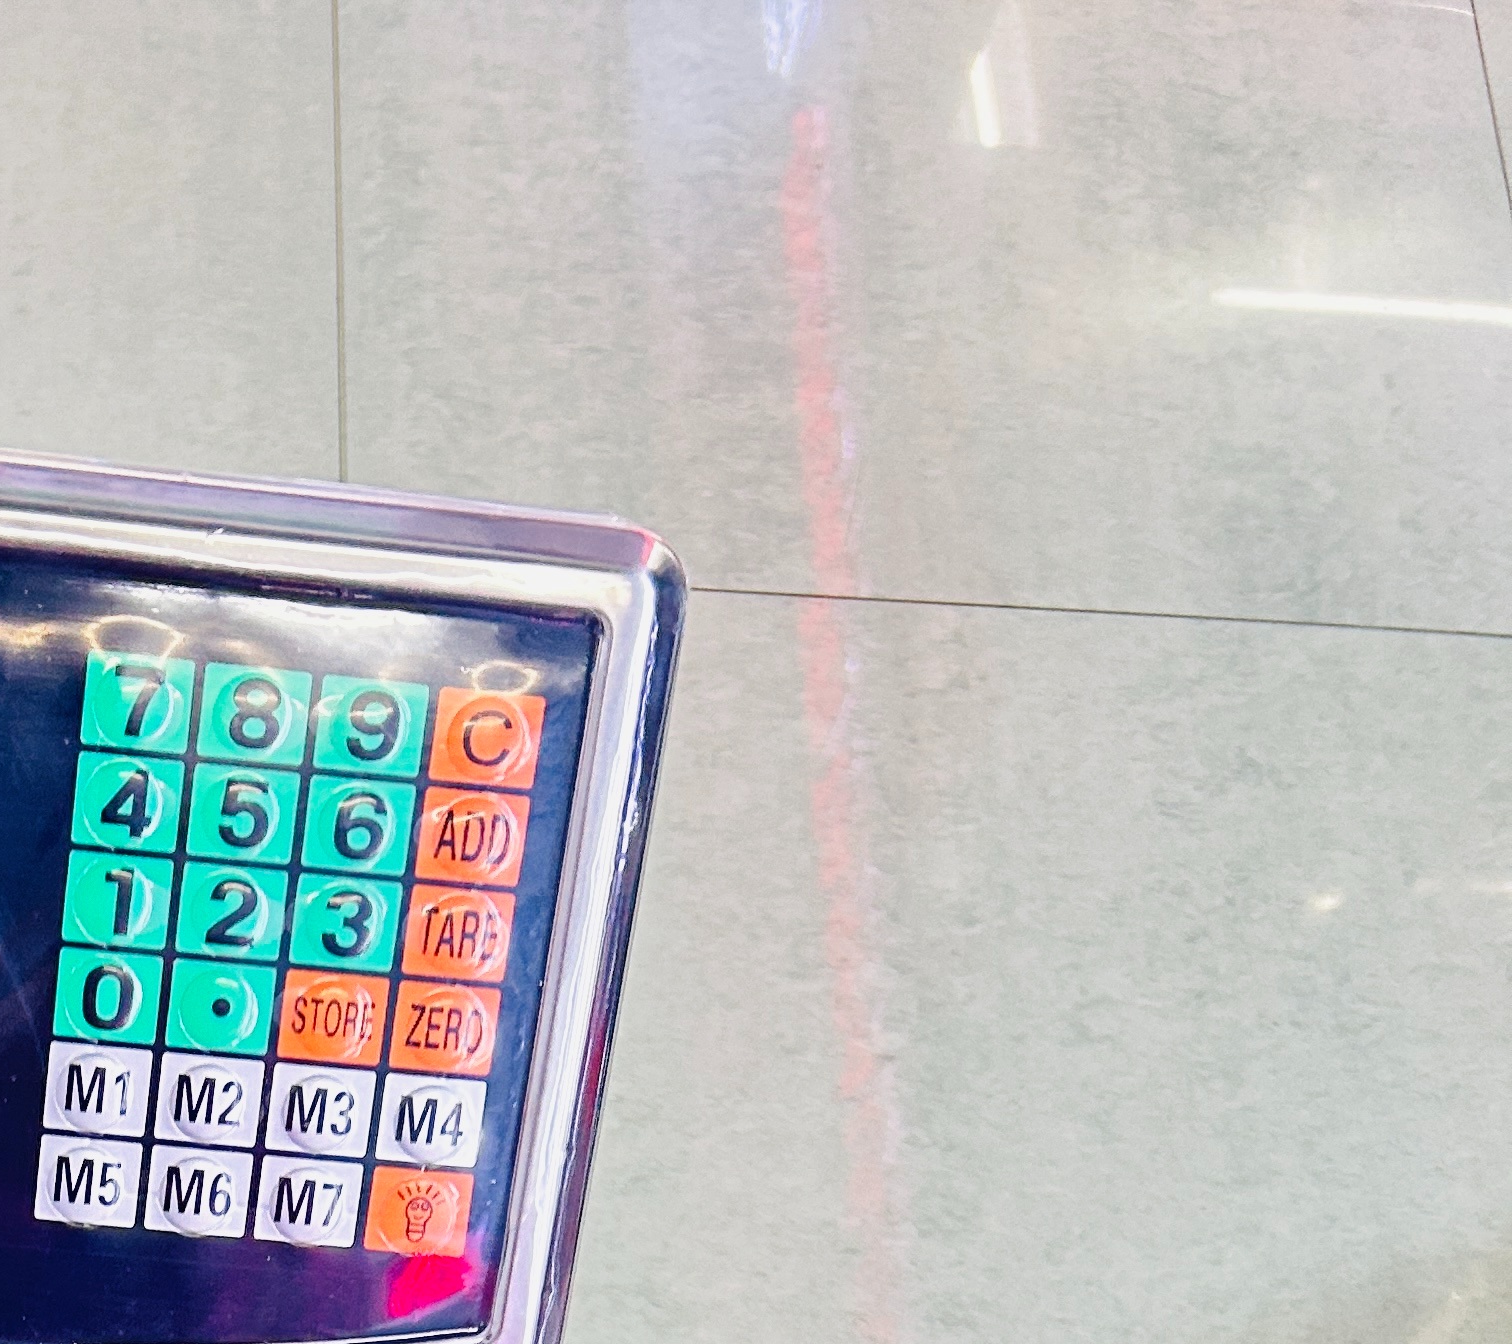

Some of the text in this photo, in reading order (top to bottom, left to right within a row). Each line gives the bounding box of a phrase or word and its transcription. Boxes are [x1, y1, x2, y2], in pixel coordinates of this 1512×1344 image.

[115, 665, 166, 737] 7
[229, 677, 283, 749] 8
[345, 690, 401, 761] 9
[462, 710, 512, 768] C
[101, 769, 152, 839] 4
[218, 779, 271, 848] 5
[333, 791, 388, 860] 6
[433, 809, 511, 865] ADD
[105, 867, 135, 937] 1
[205, 878, 258, 949] 2
[321, 890, 374, 958] 3
[421, 904, 500, 962] TARE
[81, 965, 136, 1031] 0
[291, 997, 376, 1041] STORE
[405, 1003, 484, 1056] ZERO
[64, 1063, 130, 1117] M1
[173, 1075, 244, 1128] M2
[284, 1085, 354, 1137] M3
[394, 1095, 464, 1147] M4
[53, 1155, 122, 1207] M5
[162, 1166, 232, 1218] M6
[273, 1175, 343, 1228] M7
